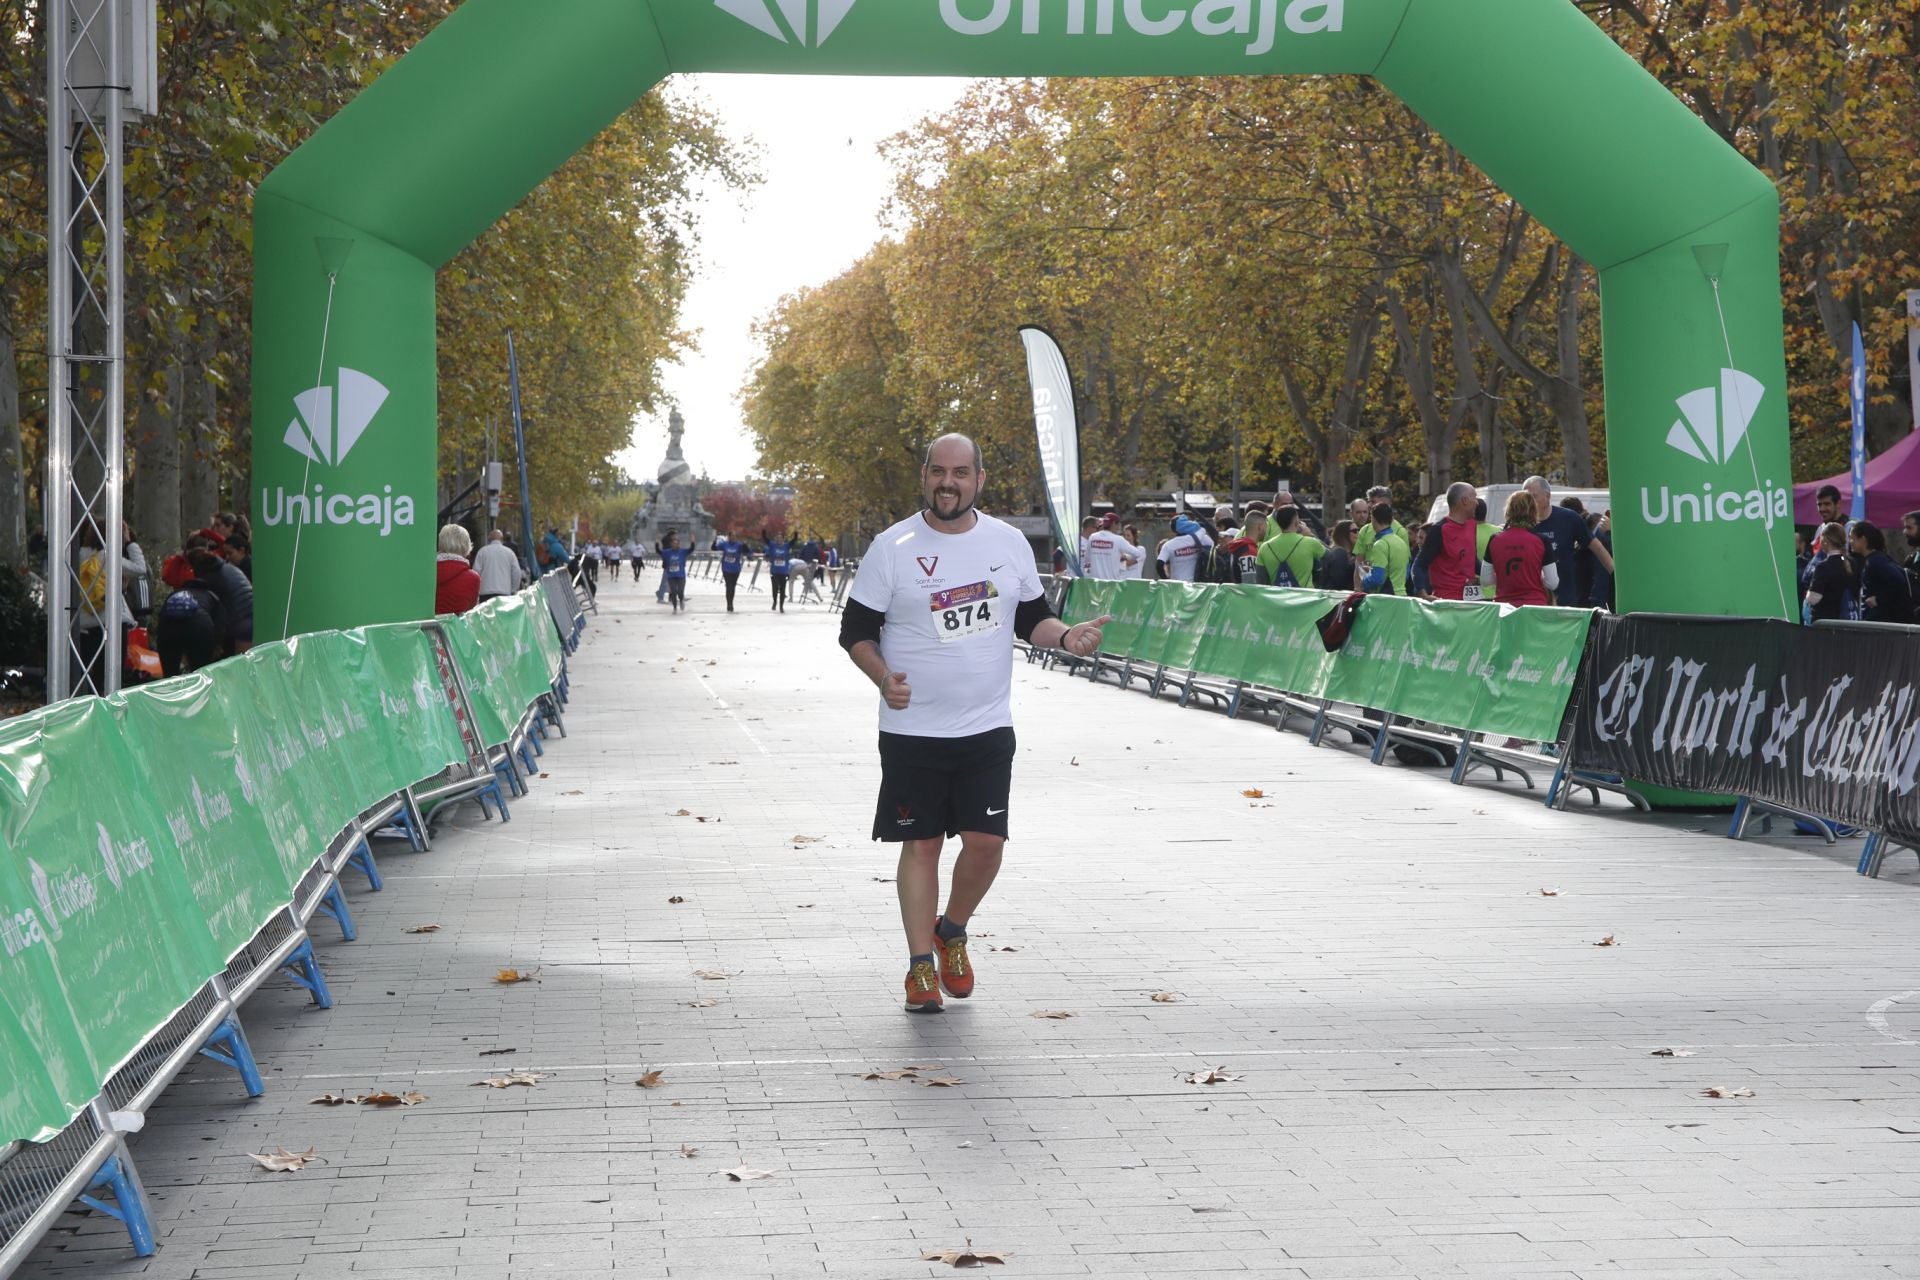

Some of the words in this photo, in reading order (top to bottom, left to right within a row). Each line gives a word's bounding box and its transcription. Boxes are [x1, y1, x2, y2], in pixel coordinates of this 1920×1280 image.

[262, 483, 414, 536] Unicaja
[1641, 479, 1788, 530] Unicaja
[943, 601, 991, 631] 874
[1596, 654, 1654, 747] El
[1653, 656, 1766, 760] Norte
